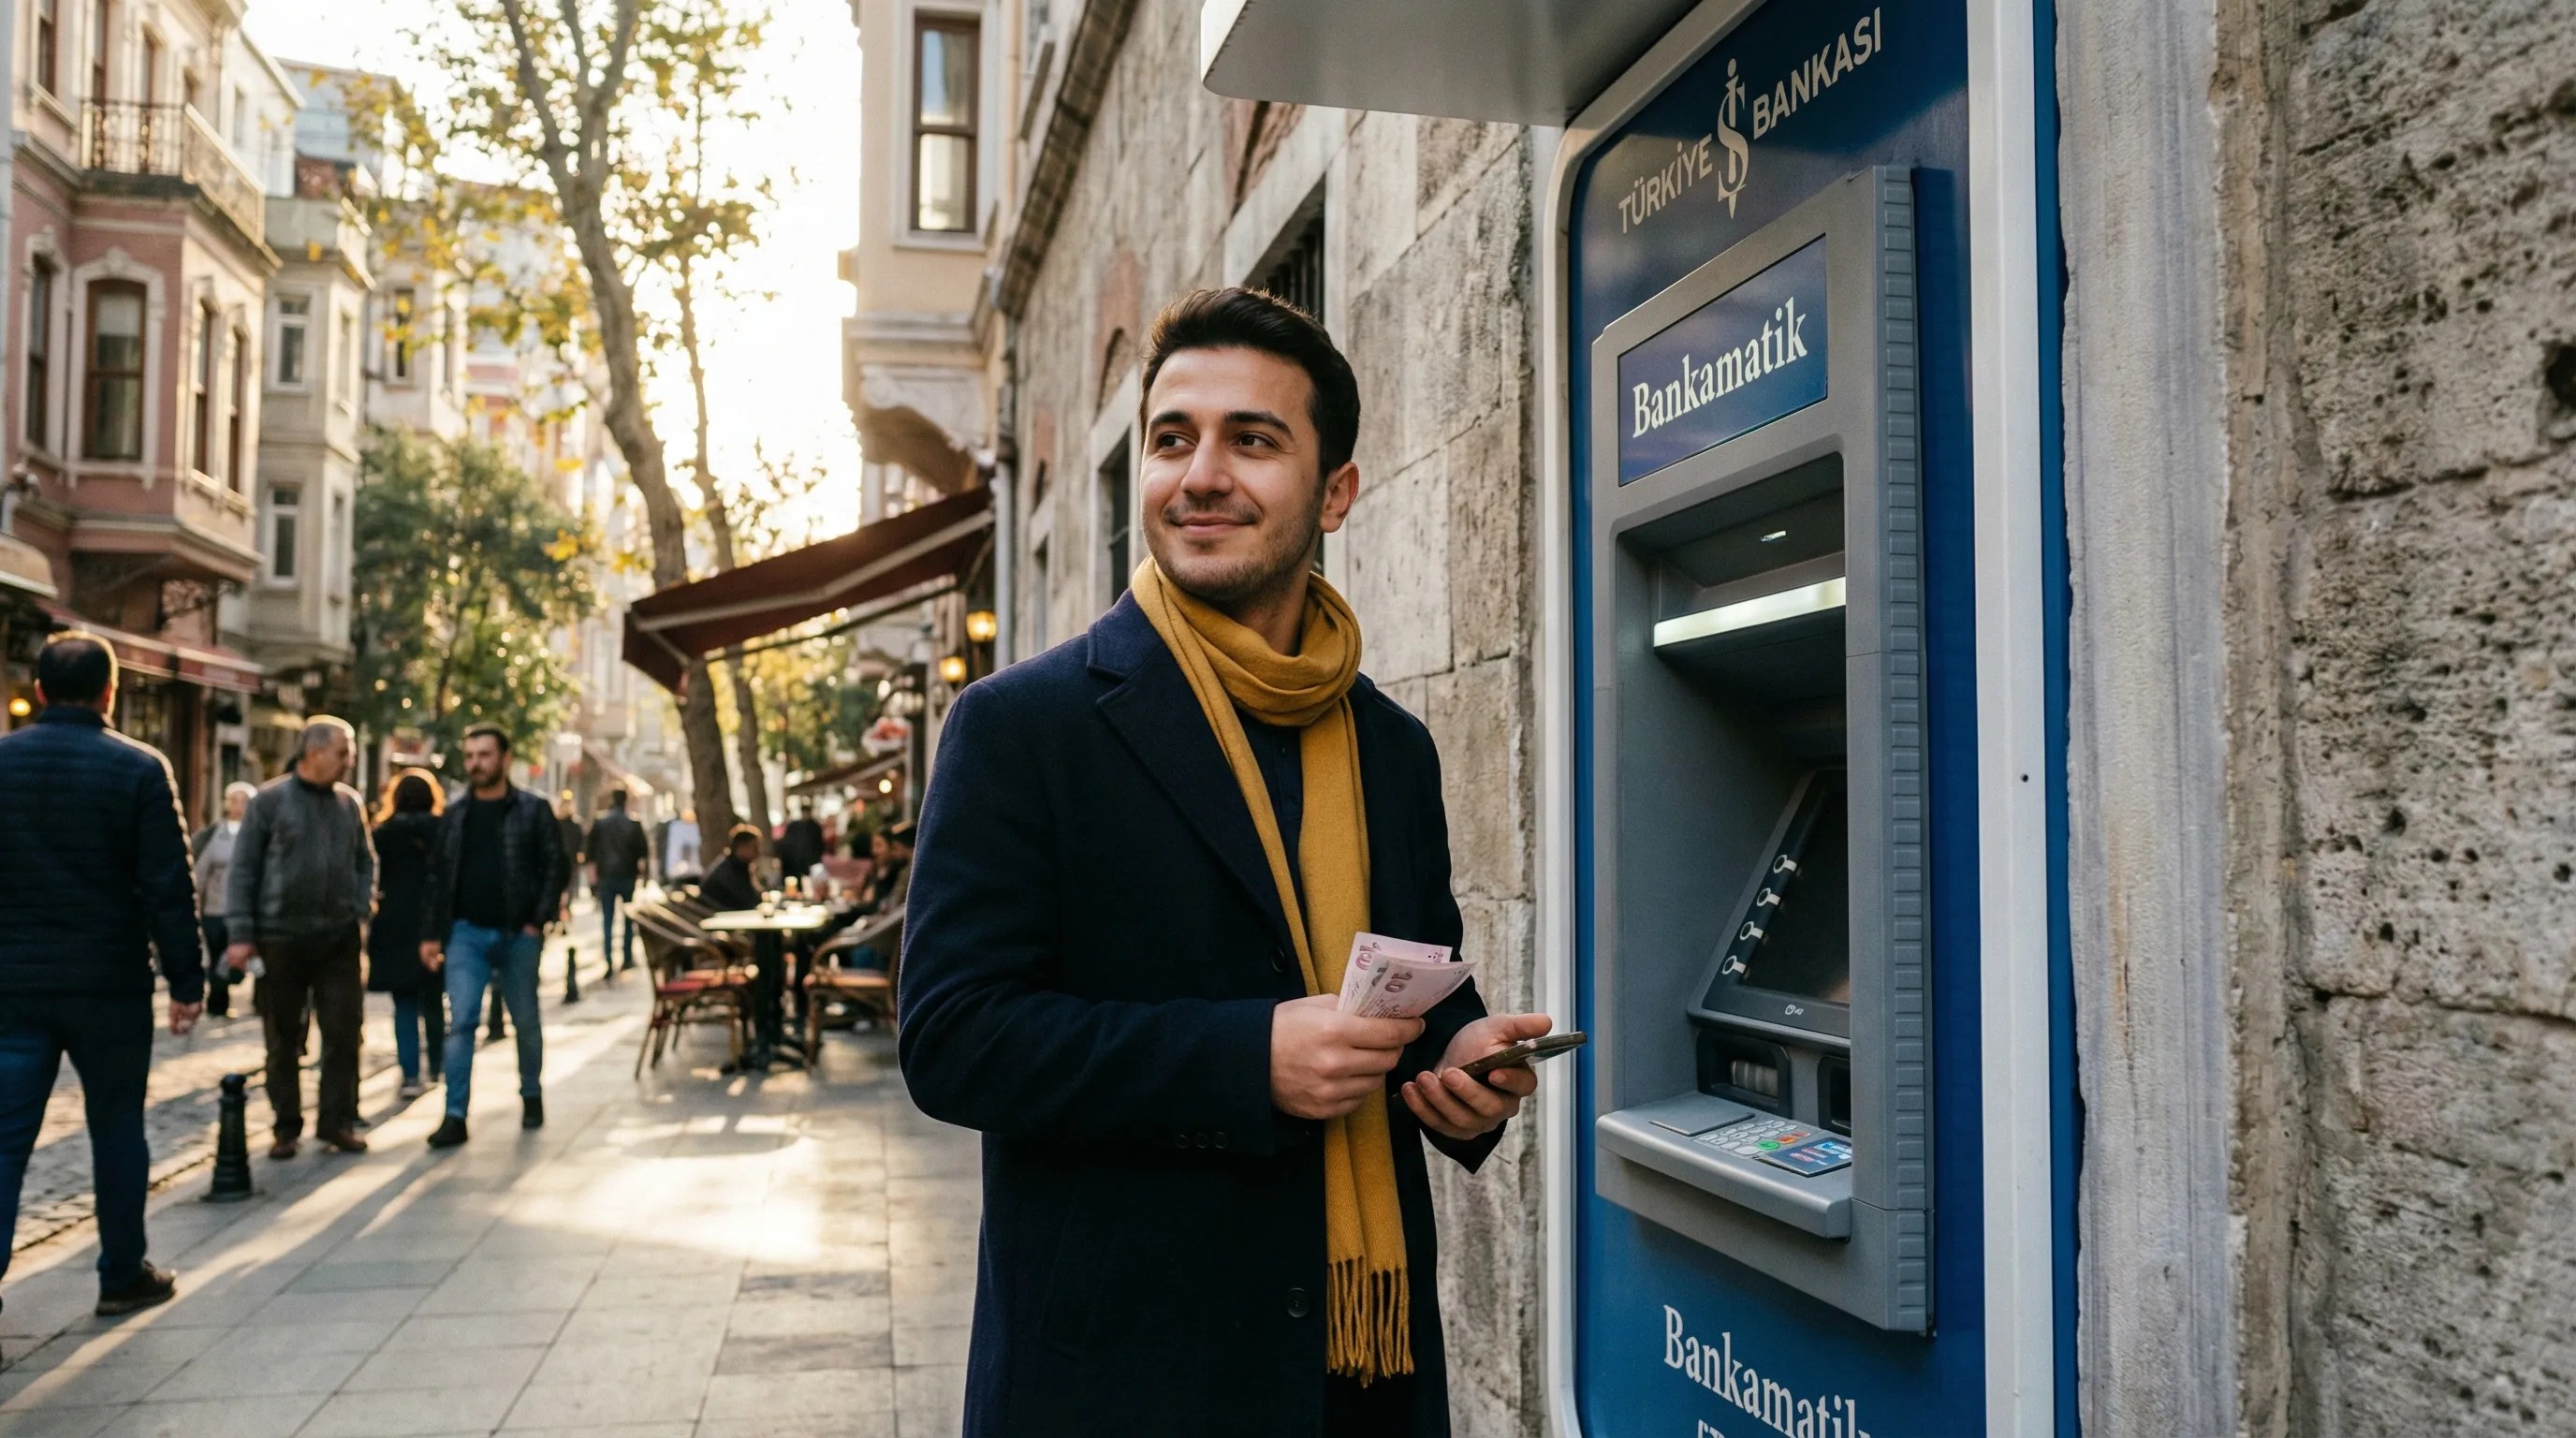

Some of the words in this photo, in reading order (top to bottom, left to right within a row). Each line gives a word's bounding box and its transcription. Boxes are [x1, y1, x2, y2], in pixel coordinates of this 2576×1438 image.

[1617, 132, 1713, 235] TÜRKİYE
[1753, 7, 1881, 140] BANKASI
[1632, 296, 1808, 439] Bankamatik
